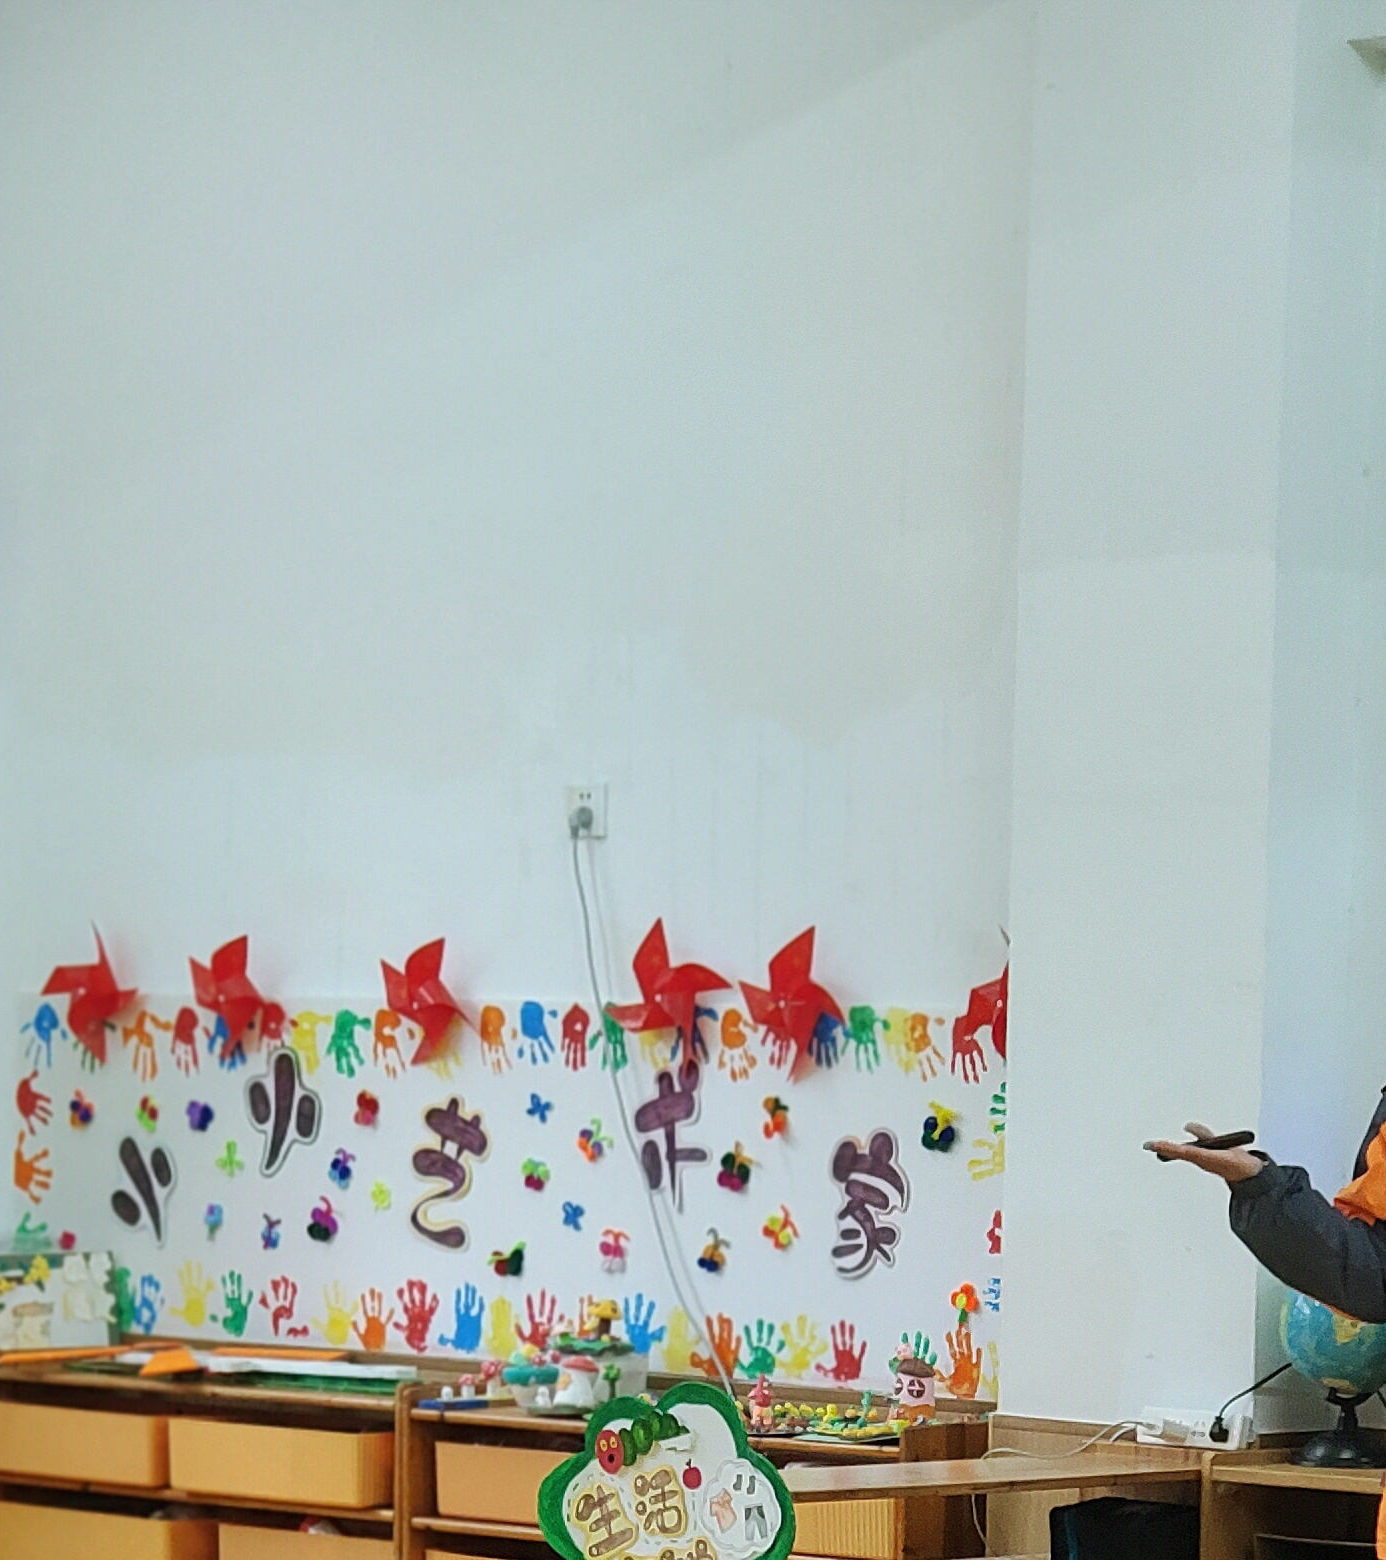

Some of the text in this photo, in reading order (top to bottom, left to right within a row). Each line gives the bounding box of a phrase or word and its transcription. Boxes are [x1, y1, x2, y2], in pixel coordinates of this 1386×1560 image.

[112, 1050, 909, 1278] 小小艺术家
[576, 1468, 684, 1558] 生活
